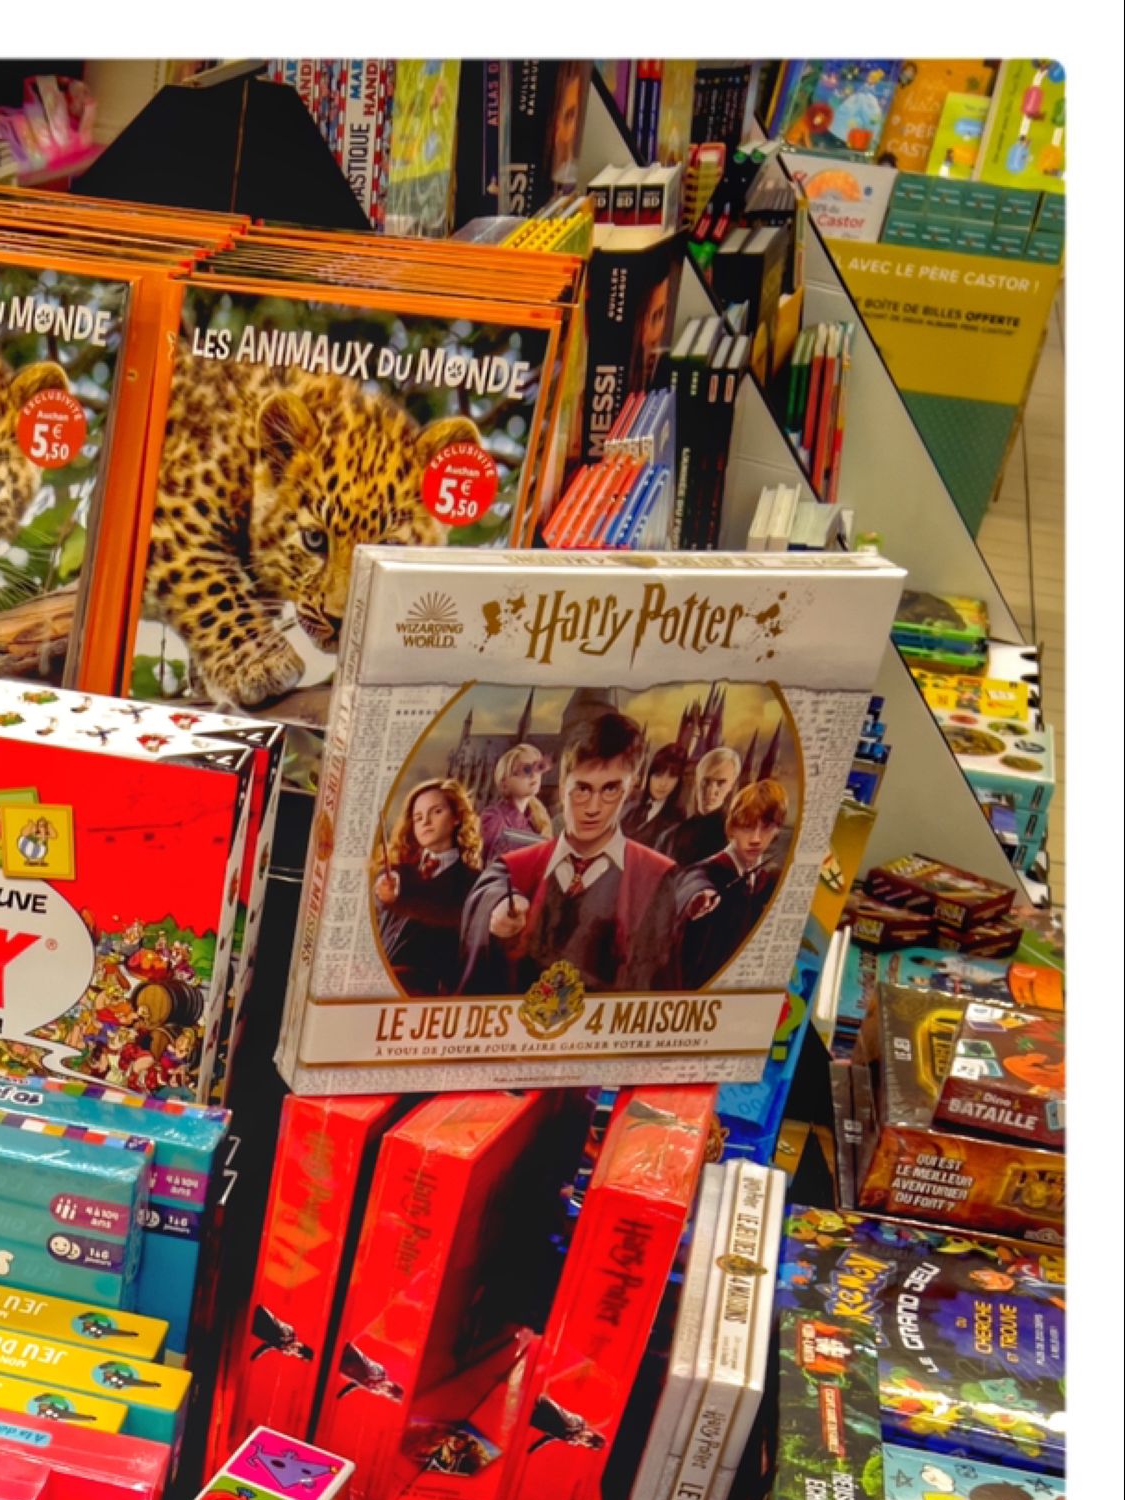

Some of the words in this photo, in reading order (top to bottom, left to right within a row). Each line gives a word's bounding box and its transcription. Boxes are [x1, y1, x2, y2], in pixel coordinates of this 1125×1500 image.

[848, 257, 892, 275] AVEC
[895, 263, 914, 278] LE
[918, 264, 959, 284] PÈRE
[963, 271, 1030, 293] CASTOR
[9, 296, 112, 347] MONDE
[903, 304, 920, 318] DE
[923, 304, 962, 321] BILLES
[965, 310, 1020, 328] OFFERTE
[192, 327, 232, 360] LES
[236, 325, 373, 380] ANIMAUX
[377, 349, 413, 381] DU
[416, 347, 529, 399] MONDE
[36, 410, 69, 422] Auchan
[589, 364, 618, 458] MESSI
[396, 622, 464, 636] WIZARDING
[523, 590, 633, 665] Harry
[630, 582, 744, 670] Potter
[376, 1007, 408, 1041] LE
[410, 1006, 461, 1040] JEU
[464, 1004, 513, 1039] DES
[584, 1003, 604, 1034] 4
[609, 1000, 722, 1034] MAISONS
[386, 1046, 418, 1056] VOUS
[422, 1045, 438, 1055] DE
[441, 1044, 476, 1055] JOUER
[484, 1043, 517, 1052] POUR
[522, 1042, 555, 1052] FAIRE
[560, 1041, 608, 1050] GAGNER
[613, 1039, 651, 1049] VOTRE
[655, 1038, 702, 1048] MAISON
[948, 1098, 1039, 1131] BATAILLE
[892, 1178, 968, 1200] AVENTURIER
[613, 1217, 653, 1265] Harry
[595, 1264, 644, 1328] Potter
[897, 1293, 924, 1350] GRAND
[913, 1262, 941, 1292] JEU
[974, 1300, 992, 1354] CHERCHE
